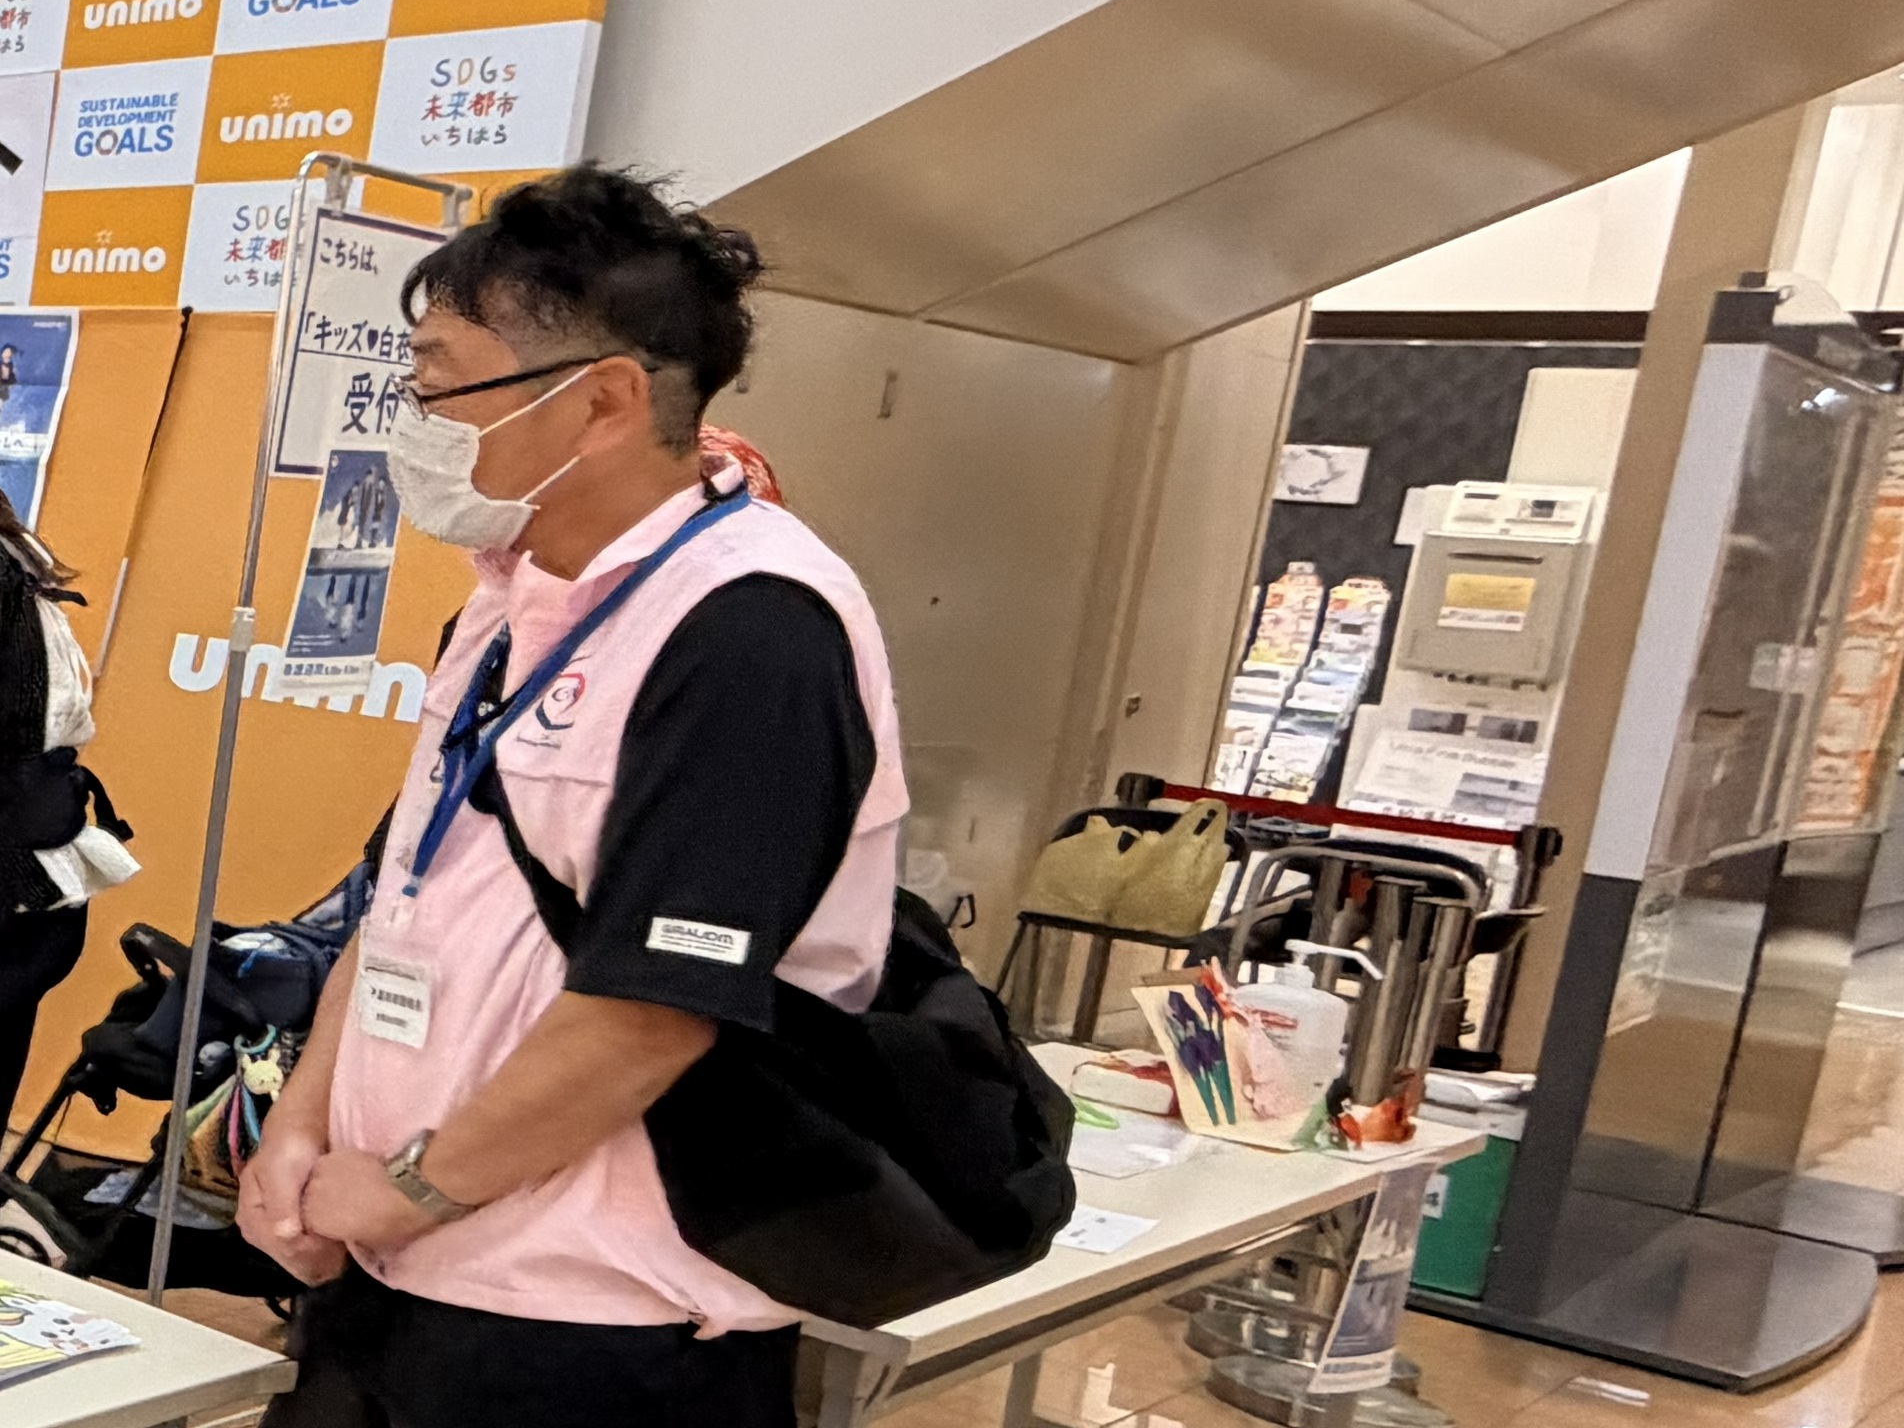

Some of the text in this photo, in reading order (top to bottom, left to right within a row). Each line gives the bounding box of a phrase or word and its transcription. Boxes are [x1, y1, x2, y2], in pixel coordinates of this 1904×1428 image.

[430, 56, 516, 88] SDGs
[77, 109, 176, 129] DEVELOPMENT
[79, 93, 179, 113] SUSTAINABLE
[420, 90, 518, 122] 未来都市
[74, 124, 174, 157] GOALS
[219, 108, 353, 144] unimo
[420, 123, 508, 146] いちはら
[51, 246, 166, 275] unimo
[320, 238, 378, 274] こちらは、
[342, 372, 401, 435] 受付
